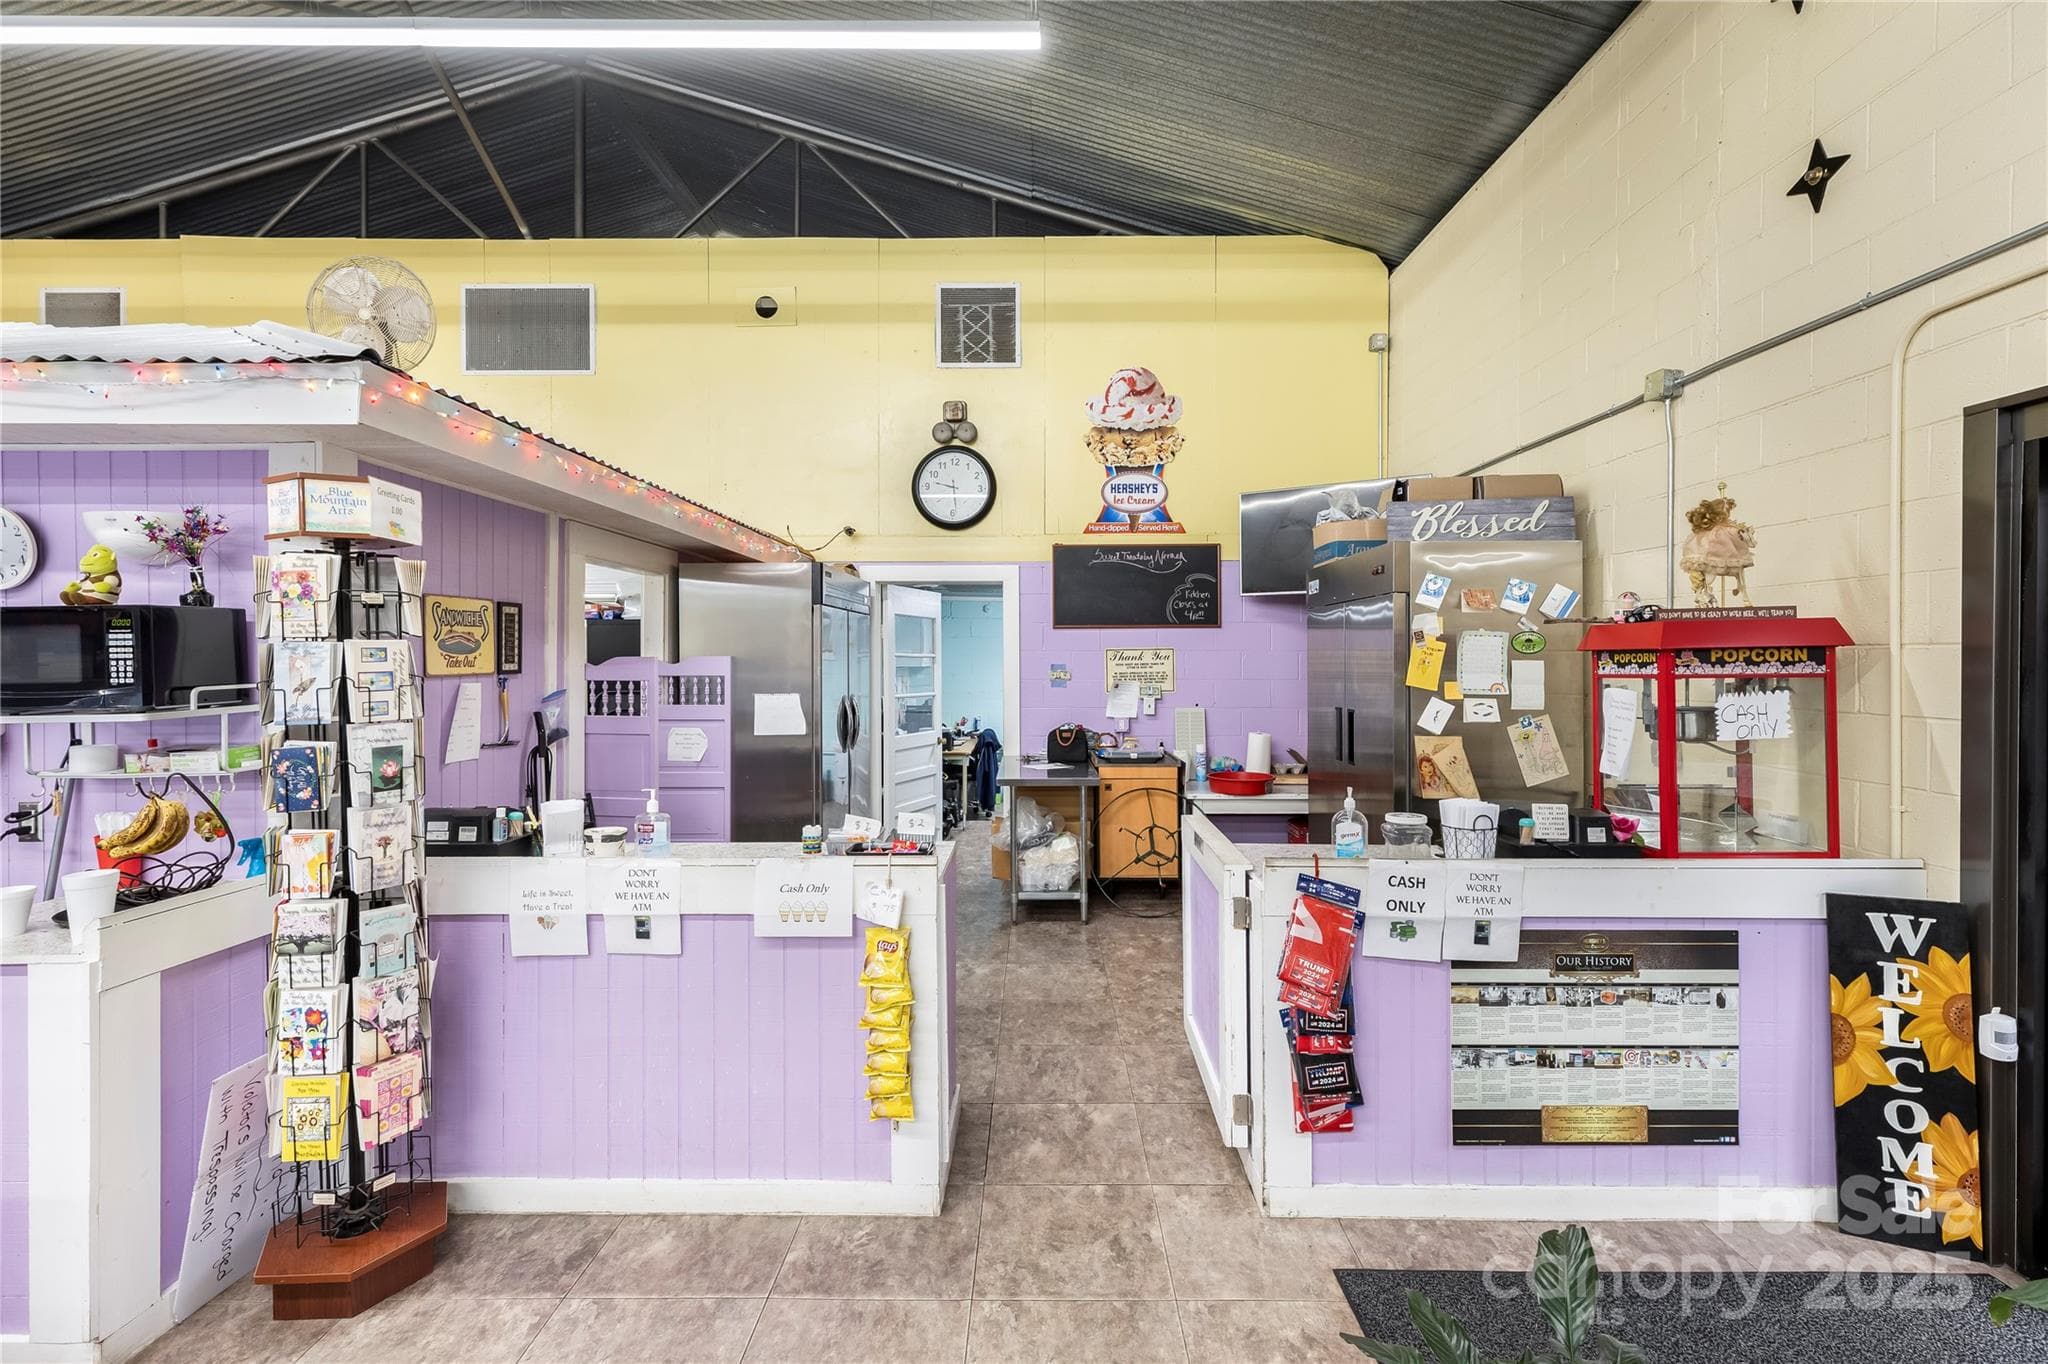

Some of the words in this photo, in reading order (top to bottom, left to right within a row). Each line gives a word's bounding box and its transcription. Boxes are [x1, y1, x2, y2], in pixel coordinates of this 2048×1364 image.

[950, 458, 961, 466] 12
[929, 471, 939, 479] 10
[974, 472, 980, 480] 2
[328, 486, 353, 496] Blue
[924, 482, 931, 491] 9
[977, 485, 983, 493] 3
[1110, 483, 1158, 494] HERSHEY'S
[310, 494, 367, 508] Mountain
[377, 487, 401, 499] Greeting
[400, 494, 416, 506] Cards
[1113, 495, 1124, 504] Ice
[1127, 495, 1156, 505] Cream
[328, 506, 354, 516] Arts
[949, 509, 956, 517] 6
[1411, 499, 1550, 542] Blessed
[14, 528, 22, 537] 2
[18, 554, 26, 566] 4
[1094, 549, 1120, 562] Sweet
[10, 565, 19, 577] 5
[431, 601, 489, 642] SANDWICHES
[1109, 650, 1145, 661] Thank
[1151, 650, 1171, 661] You
[1614, 652, 1657, 664] POPCORN
[1710, 647, 1808, 663] POPCORN
[1720, 702, 1769, 724] CASH
[628, 869, 657, 878] DON'T
[1469, 872, 1500, 883] DON'T
[624, 880, 661, 889] WORRY
[1388, 875, 1427, 890] CASH
[1466, 883, 1503, 893] WORRY
[522, 889, 538, 899] Life
[539, 890, 547, 898] is
[779, 883, 804, 894] Cash
[806, 883, 831, 896] Only
[614, 892, 629, 901] WE
[629, 892, 657, 901] HAVE
[656, 892, 670, 901] AN
[1455, 896, 1472, 905] WE
[1472, 896, 1498, 905] HAVE
[1497, 897, 1512, 906] AN
[522, 903, 544, 912] Have
[552, 902, 573, 911] Treat
[632, 903, 652, 912] ATM
[1386, 899, 1426, 914] ONLY
[1473, 908, 1494, 916] ATM
[1297, 958, 1331, 975] TRUMP
[1303, 969, 1321, 980] 2024
[1298, 989, 1317, 1000] 2024
[1865, 911, 1940, 1220] WELCOME
[1308, 1066, 1345, 1078] TRUMP
[1319, 1076, 1337, 1085] 2024
[237, 1067, 266, 1146] Violators
[211, 1210, 241, 1282] Charged
